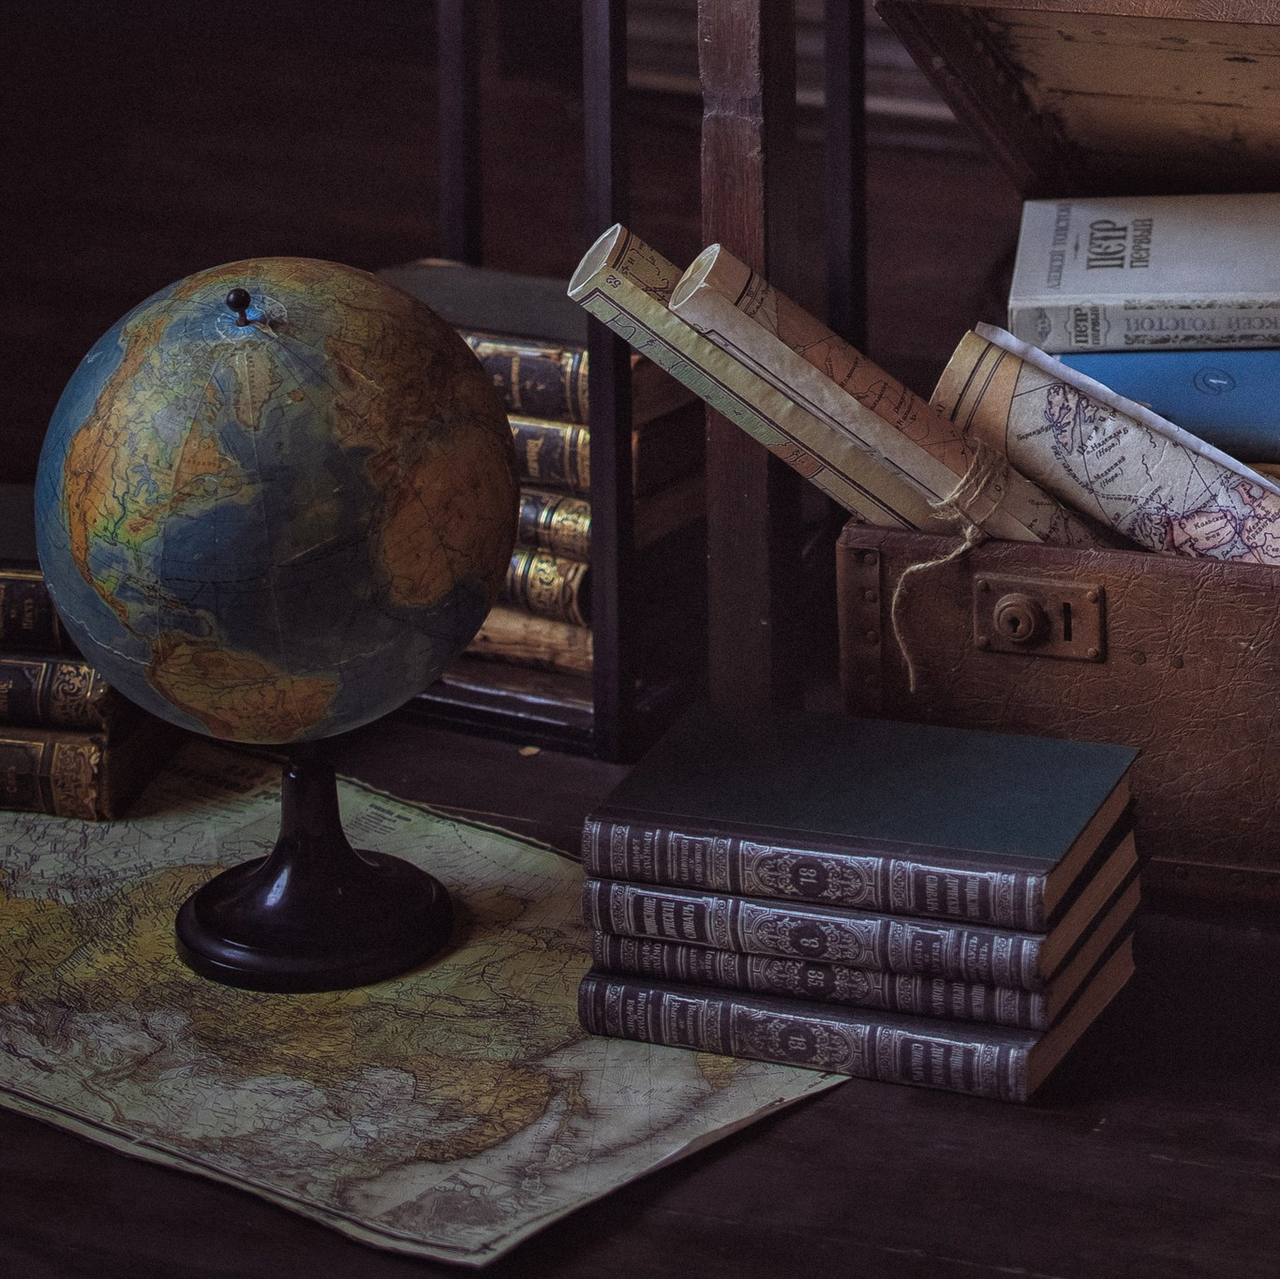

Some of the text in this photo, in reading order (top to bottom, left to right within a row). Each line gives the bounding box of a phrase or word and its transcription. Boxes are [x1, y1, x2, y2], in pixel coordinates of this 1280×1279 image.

[1086, 219, 1129, 270] ПЕТР
[1130, 218, 1153, 268] ПЕРВЫЙ
[1047, 250, 1065, 290] АЛЕКСЕЙ
[1123, 316, 1222, 333] ТОЛСТОЙ
[926, 875, 939, 912] СЛОВАРЬ
[682, 903, 697, 940] СЛОВАРЬ
[912, 1043, 925, 1081] СЛОВАРЬ
